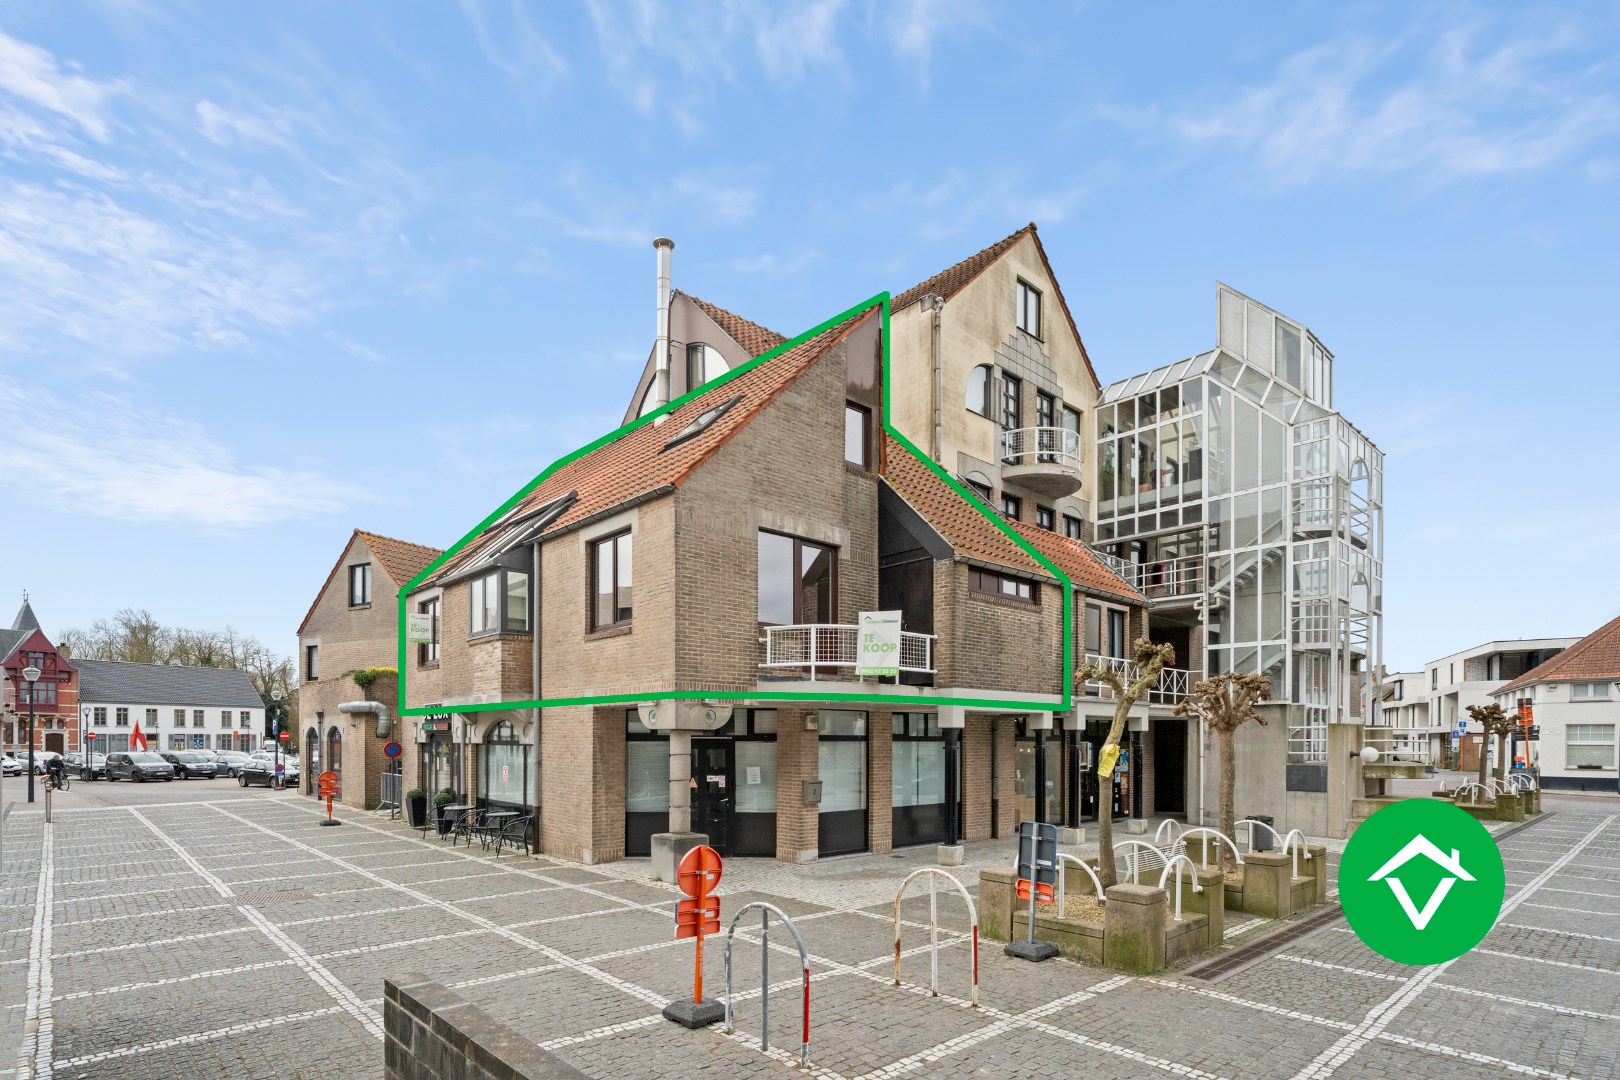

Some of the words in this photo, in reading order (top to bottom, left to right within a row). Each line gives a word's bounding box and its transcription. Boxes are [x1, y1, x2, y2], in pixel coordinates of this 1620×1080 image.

[863, 633, 875, 643] TE
[863, 643, 897, 653] KOOP
[272, 719, 277, 731] P
